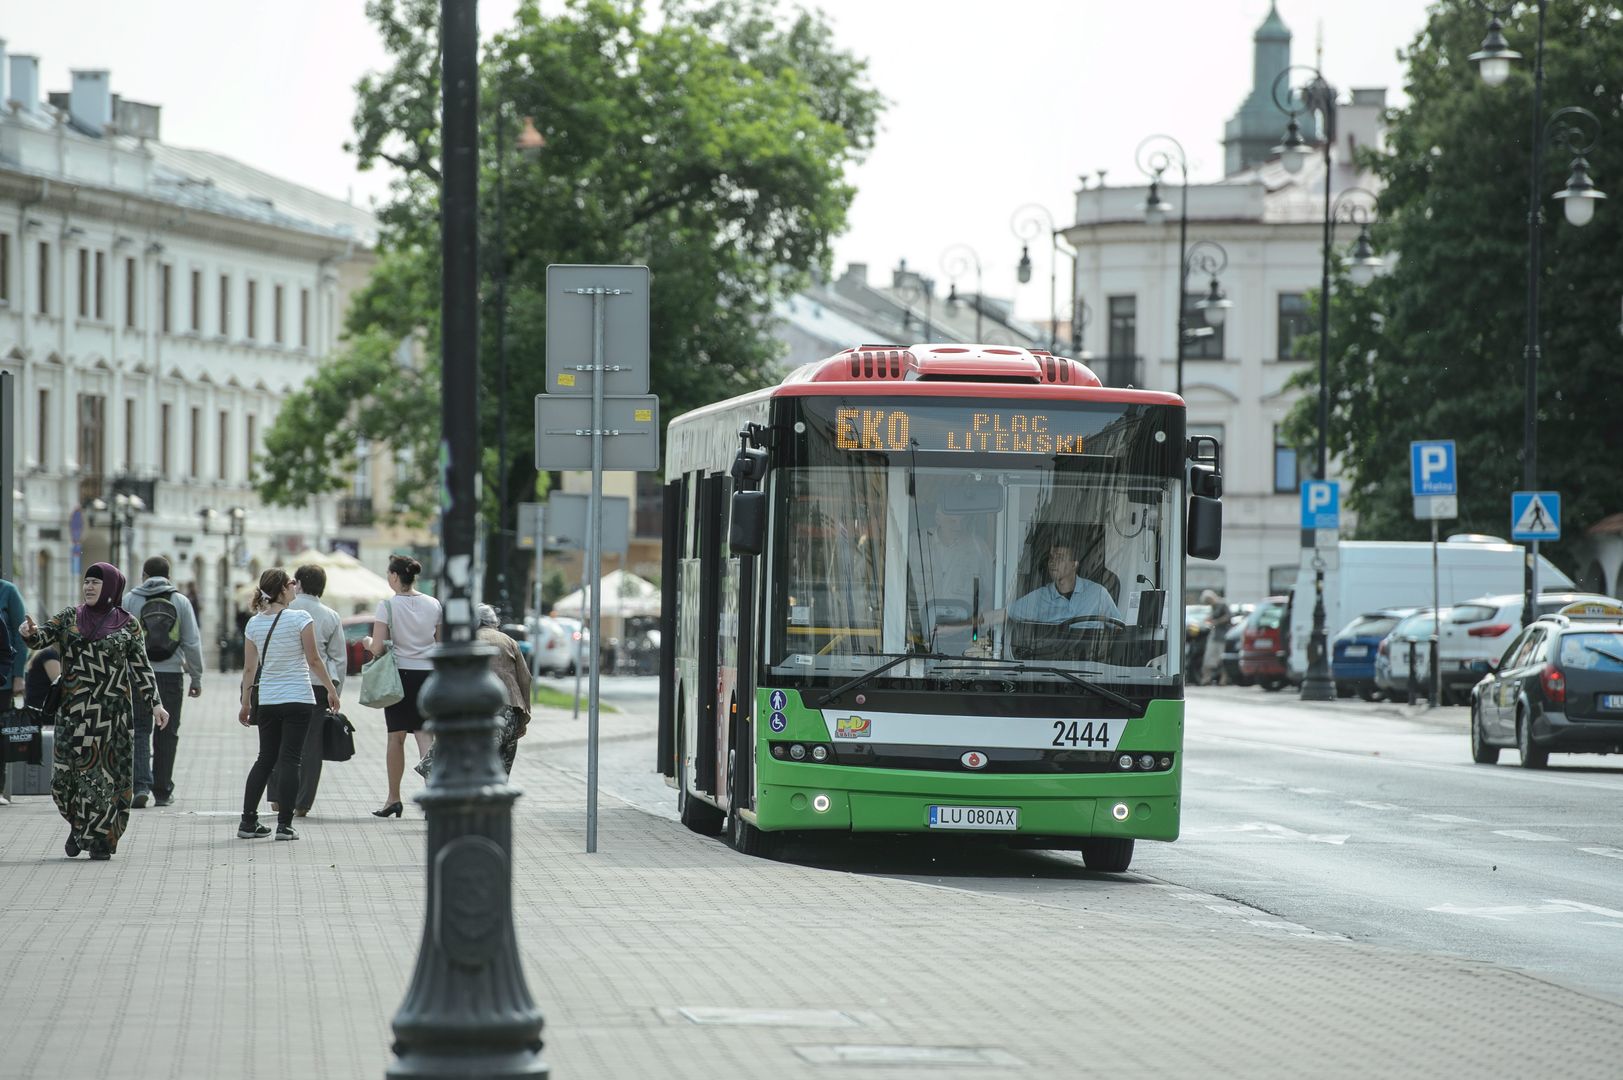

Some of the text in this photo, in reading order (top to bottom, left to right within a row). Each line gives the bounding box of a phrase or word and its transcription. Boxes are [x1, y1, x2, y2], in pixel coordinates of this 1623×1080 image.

[837, 409, 909, 450] EKO
[972, 412, 1048, 433] PLAC
[947, 431, 1083, 454] LITEWSKI
[1420, 446, 1447, 480] P
[1308, 483, 1331, 513] P
[1052, 720, 1110, 748] 2444
[940, 808, 1015, 825] LU 080AX
